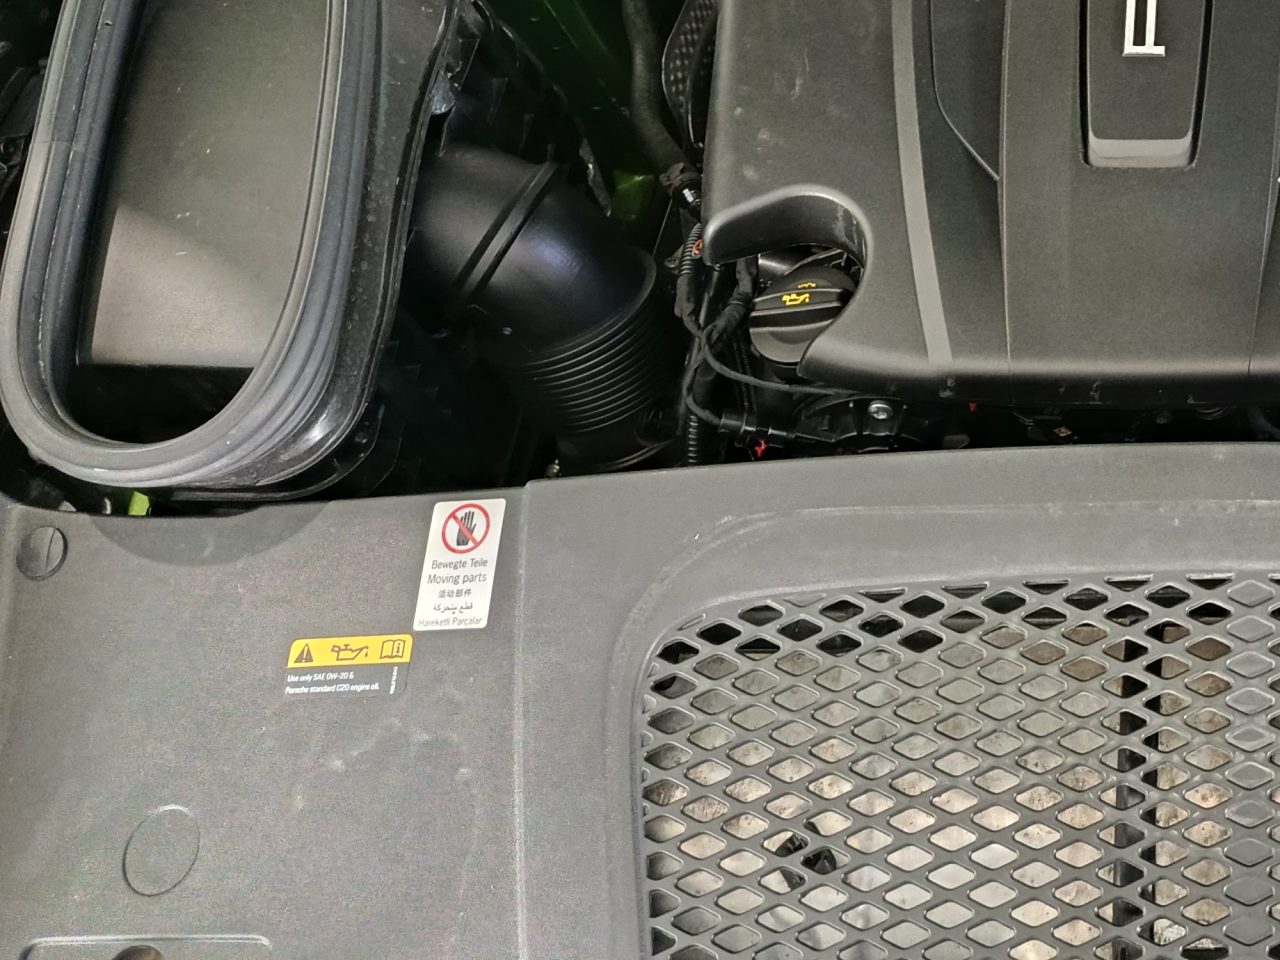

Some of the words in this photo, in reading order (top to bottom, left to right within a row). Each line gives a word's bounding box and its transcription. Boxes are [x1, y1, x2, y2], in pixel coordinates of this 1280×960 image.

[431, 559, 467, 570] Bewegte
[470, 557, 488, 568] Teile
[427, 574, 460, 585] Moving
[462, 573, 487, 584] parts
[287, 674, 299, 682] Use
[299, 673, 312, 683] only
[326, 672, 348, 680] 0W-20
[285, 686, 308, 694] Porsche
[309, 685, 336, 693] standard
[336, 683, 350, 692] C20
[350, 683, 370, 692] engine
